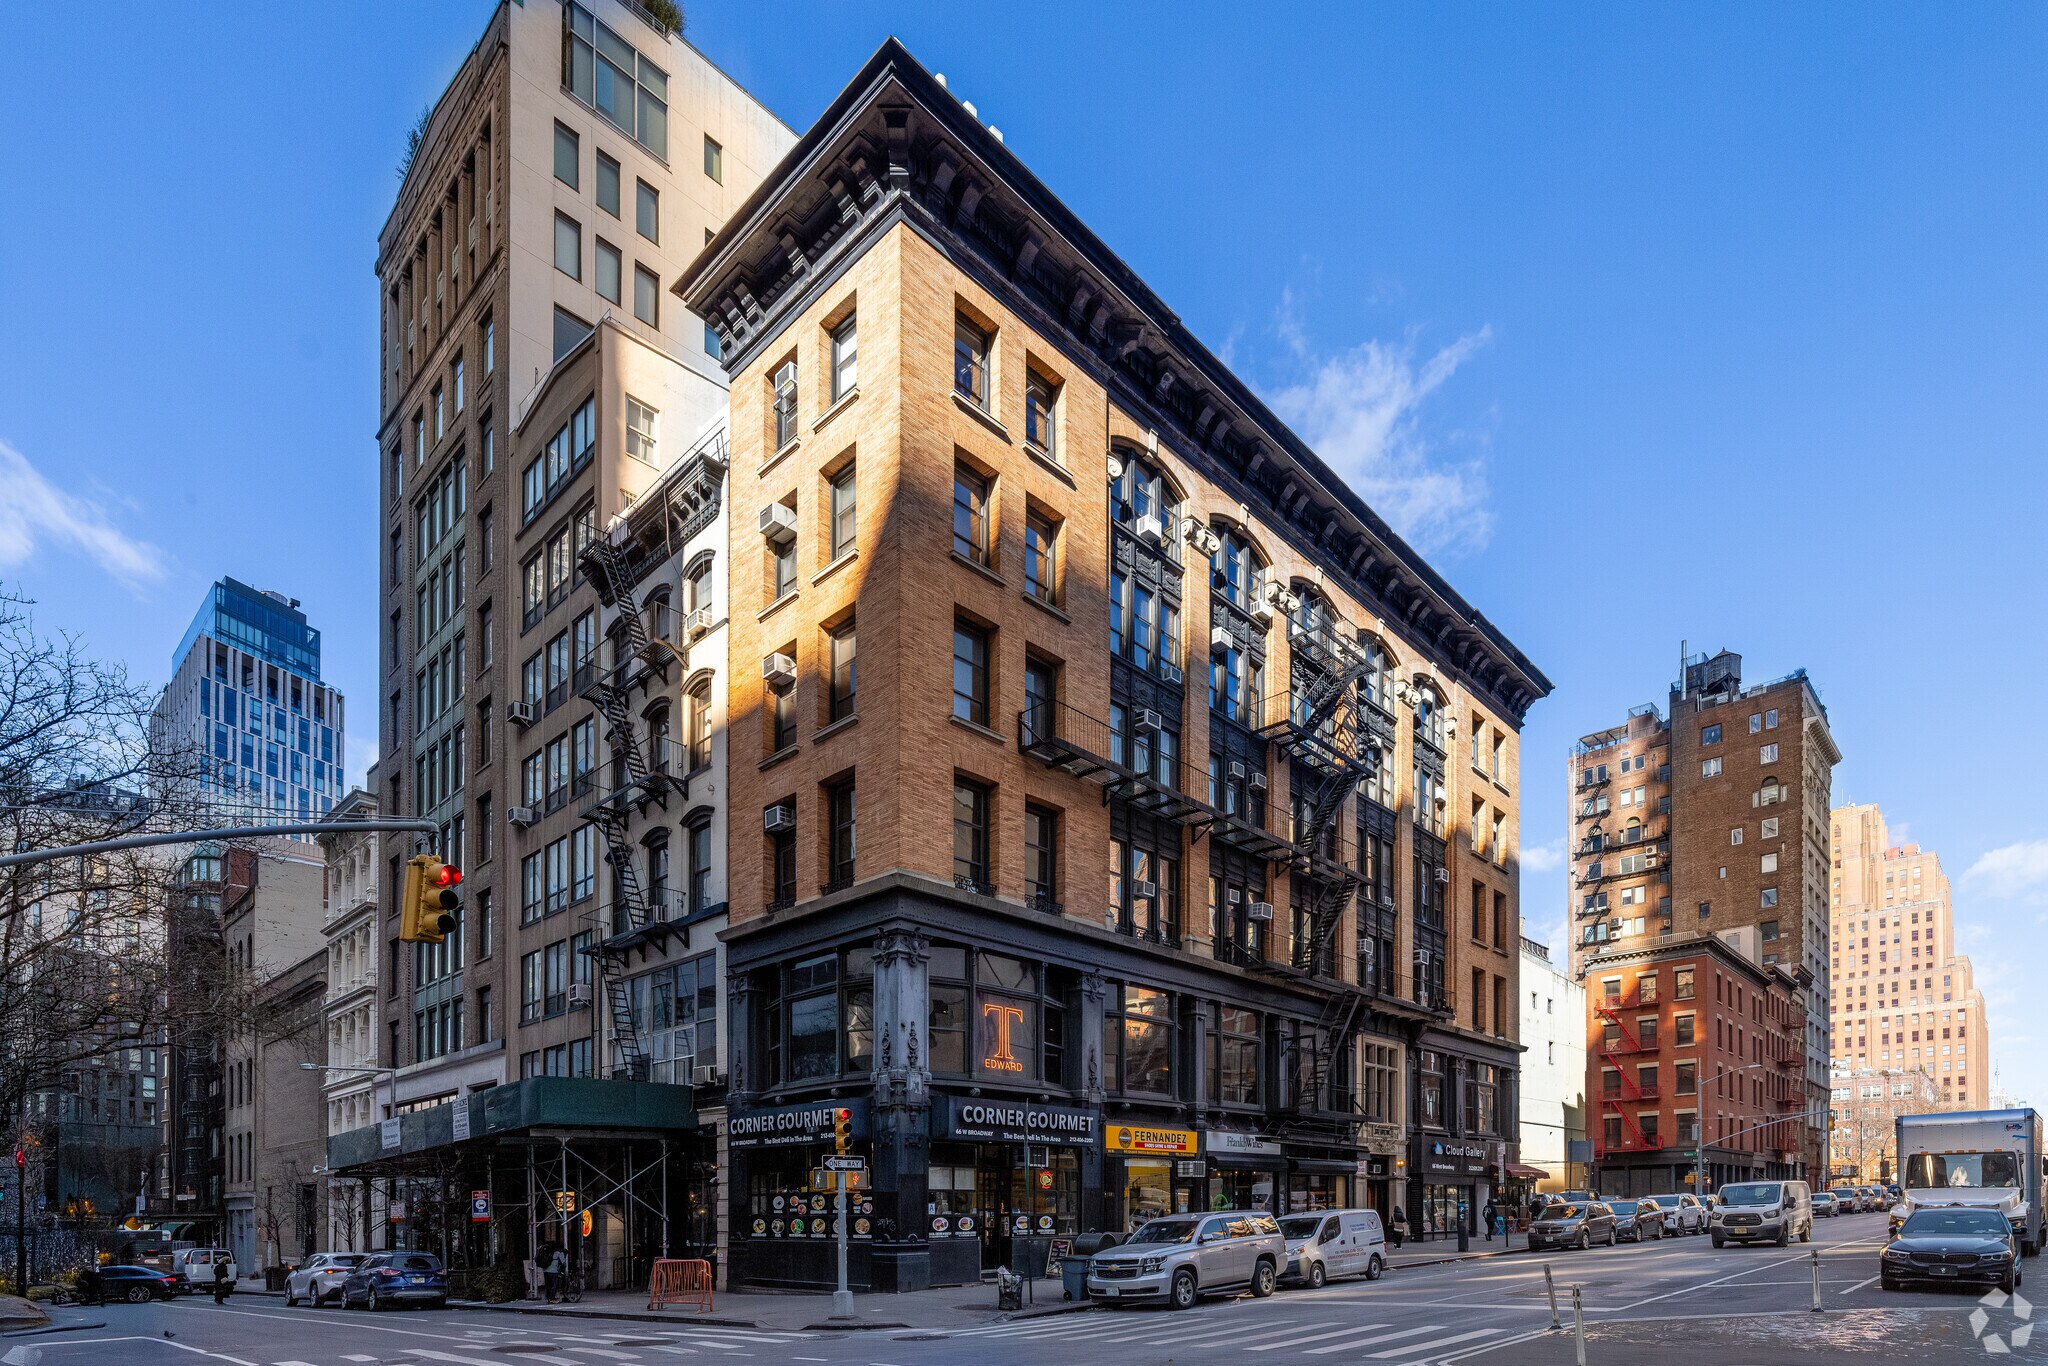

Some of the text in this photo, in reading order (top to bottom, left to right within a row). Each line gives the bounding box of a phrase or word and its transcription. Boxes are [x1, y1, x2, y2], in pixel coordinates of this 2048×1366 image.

[984, 1003, 1024, 1060] T
[984, 1058, 1023, 1072] EDWARD
[730, 1108, 836, 1135] CORNER GOURMET
[962, 1105, 1094, 1132] CORNER GOURMET
[781, 1136, 790, 1144] Deli
[802, 1134, 813, 1142] Area
[967, 1129, 994, 1137] BROADWAY
[1003, 1132, 1013, 1140] The
[1134, 1130, 1187, 1144] FERNANDEZ
[1445, 1144, 1464, 1156] Cloud
[1465, 1146, 1486, 1160] Gallery
